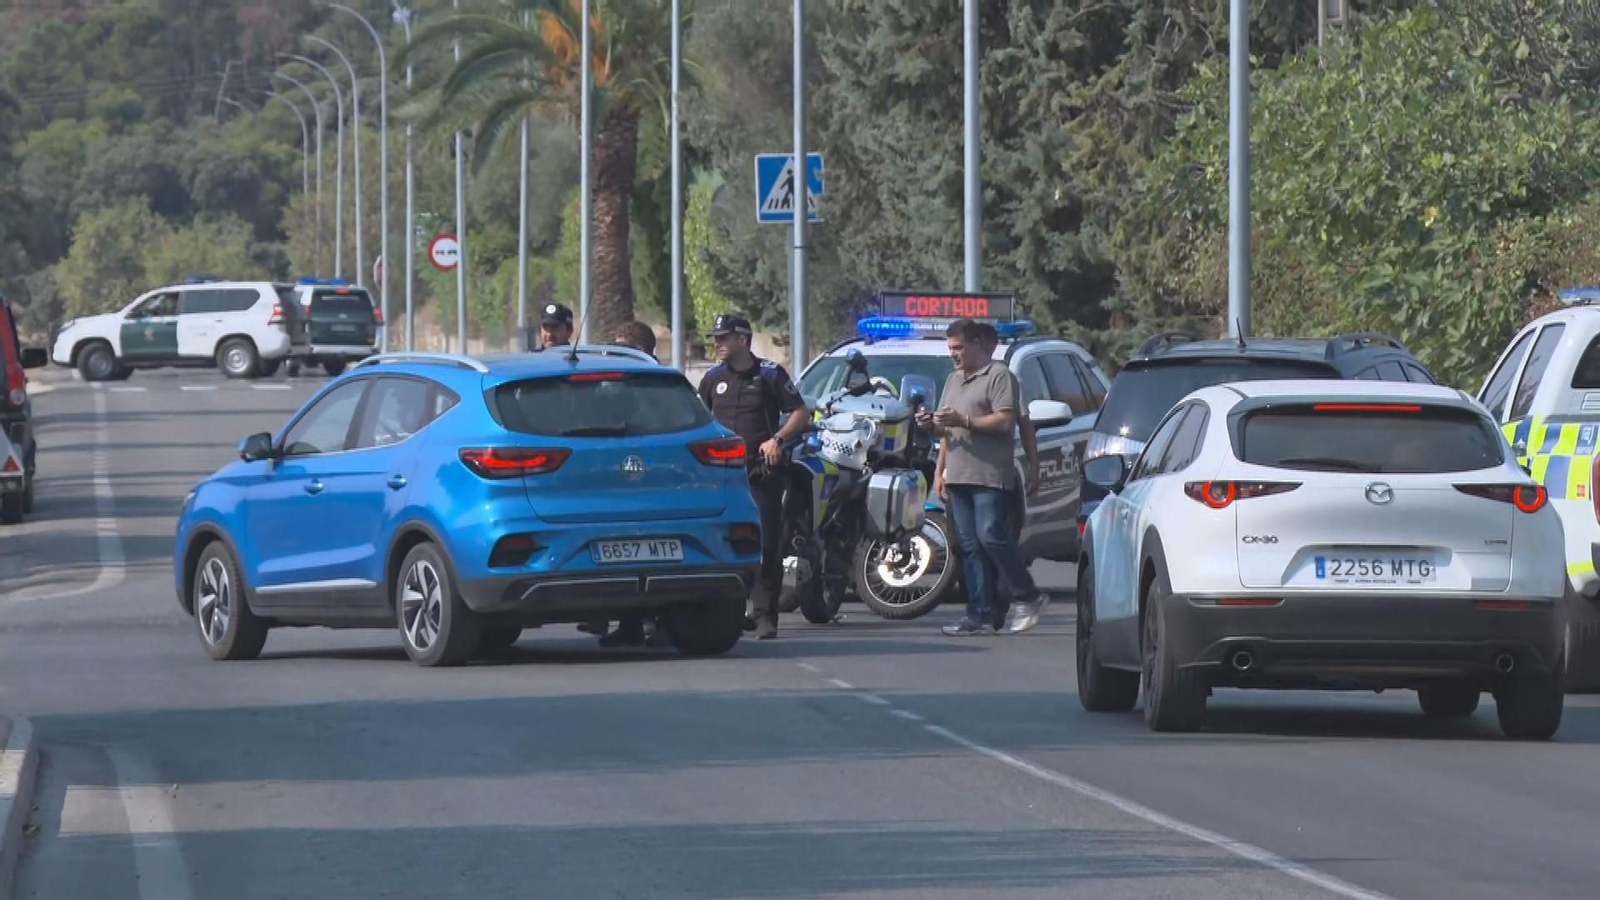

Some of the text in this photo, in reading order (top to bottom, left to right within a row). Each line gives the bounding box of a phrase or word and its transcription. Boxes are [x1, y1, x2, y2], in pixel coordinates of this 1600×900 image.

[905, 295, 989, 317] CORTADA
[1241, 534, 1279, 544] CX-30
[601, 541, 679, 559] 6657 MTP
[1330, 558, 1431, 578] 2256 MTG
